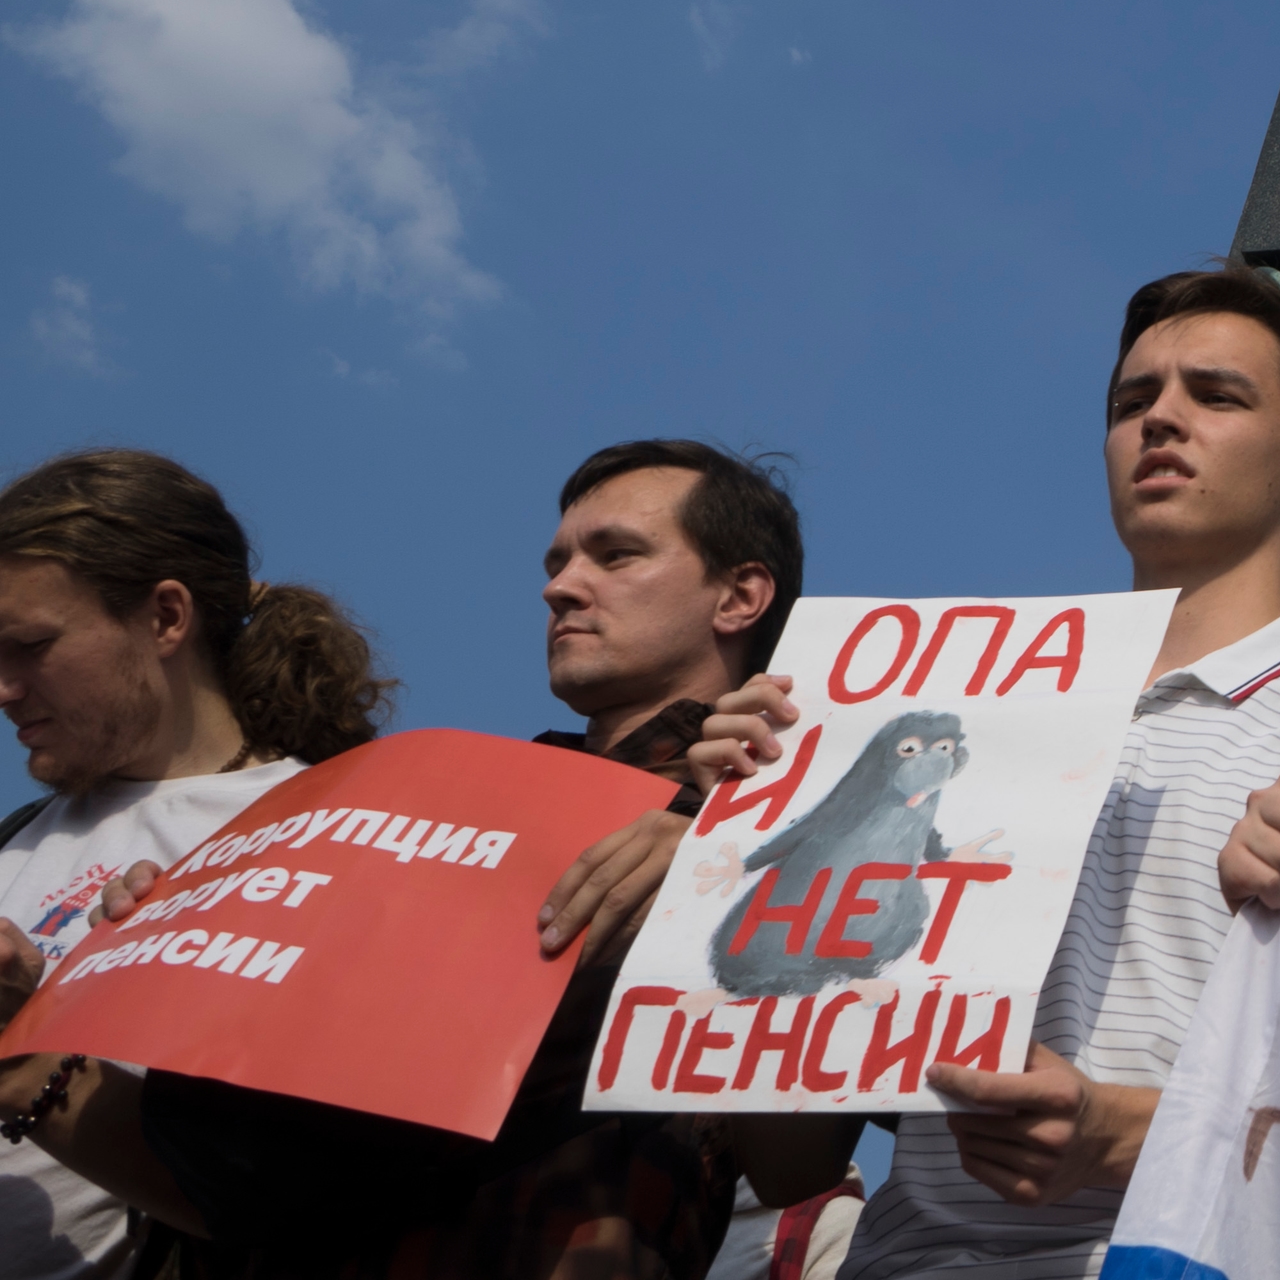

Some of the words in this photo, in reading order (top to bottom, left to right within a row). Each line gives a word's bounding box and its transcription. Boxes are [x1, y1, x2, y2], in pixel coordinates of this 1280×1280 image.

[827, 604, 1085, 704] ОПА
[694, 723, 823, 838] И
[169, 807, 518, 869] Коррупция
[114, 865, 333, 932] ворует
[727, 862, 1013, 966] НЕТ
[57, 928, 306, 985] пенсии
